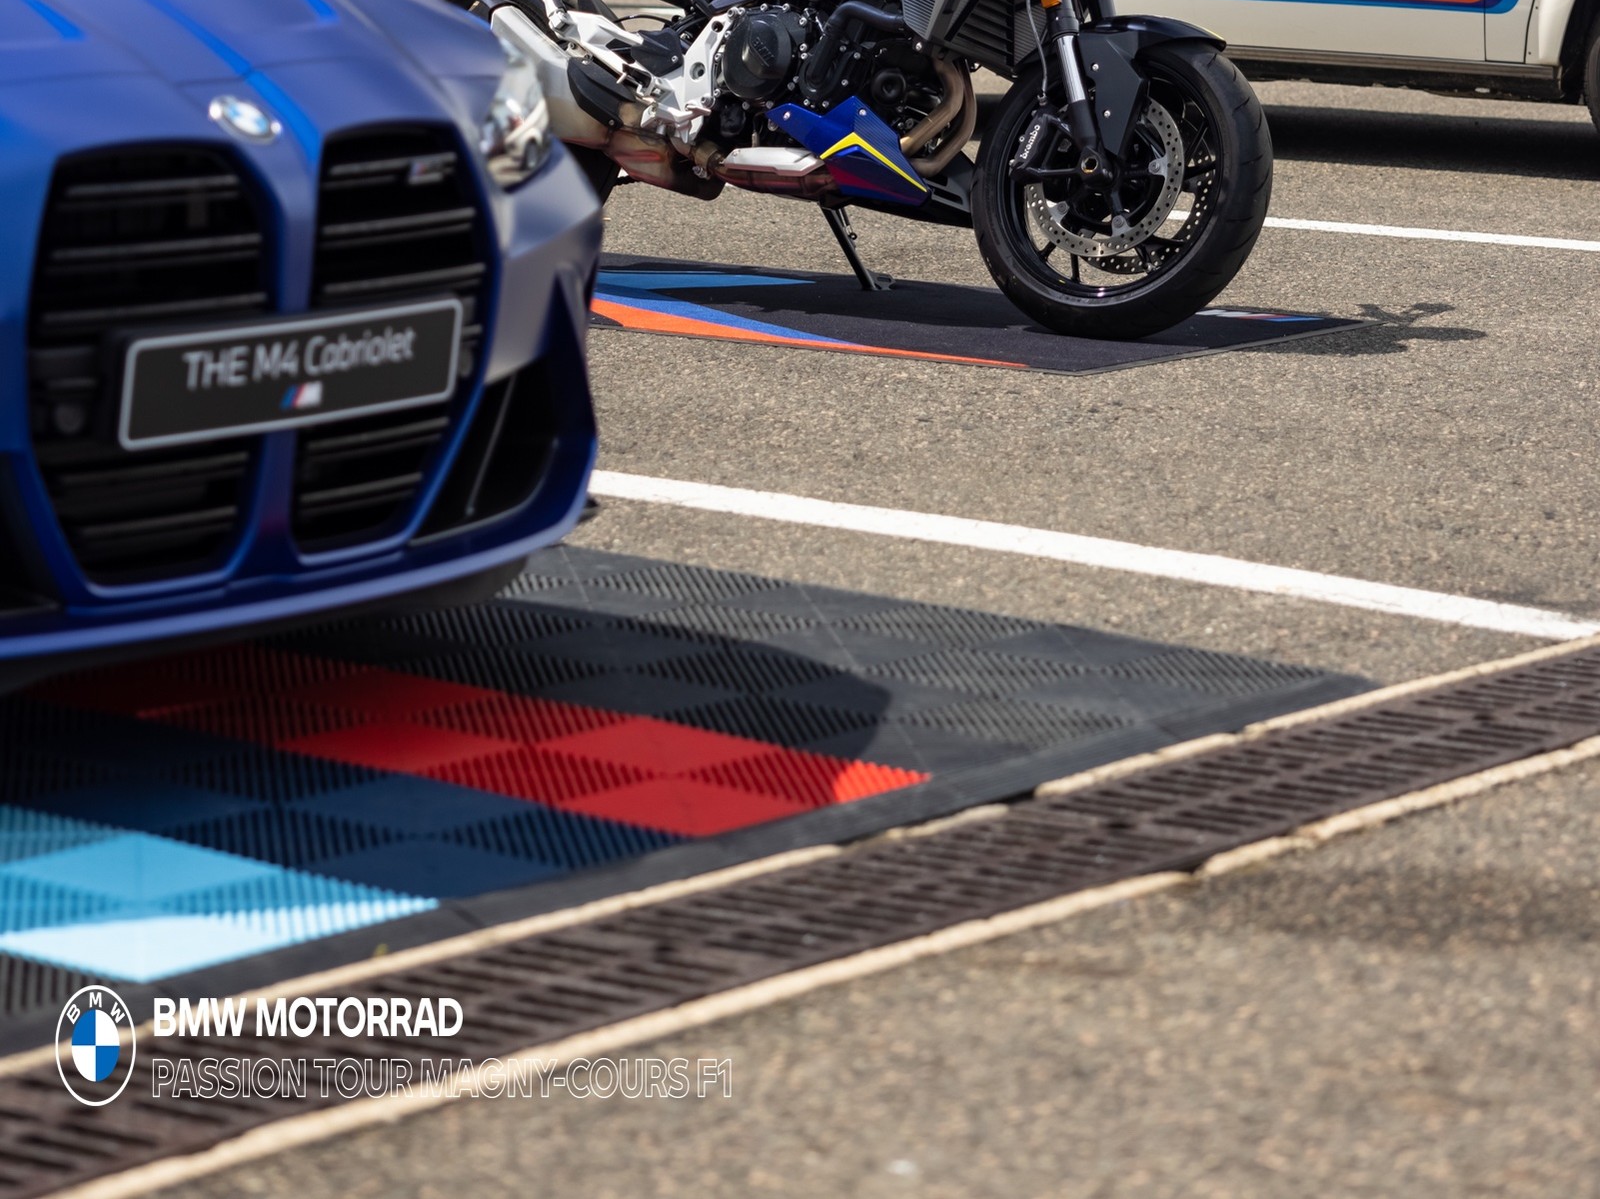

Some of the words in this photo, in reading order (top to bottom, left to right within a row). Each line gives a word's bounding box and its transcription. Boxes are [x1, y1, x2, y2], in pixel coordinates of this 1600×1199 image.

[1020, 124, 1040, 160] brembo
[182, 346, 250, 391] THE
[252, 340, 299, 383] M4
[303, 326, 417, 377] Cabriolet
